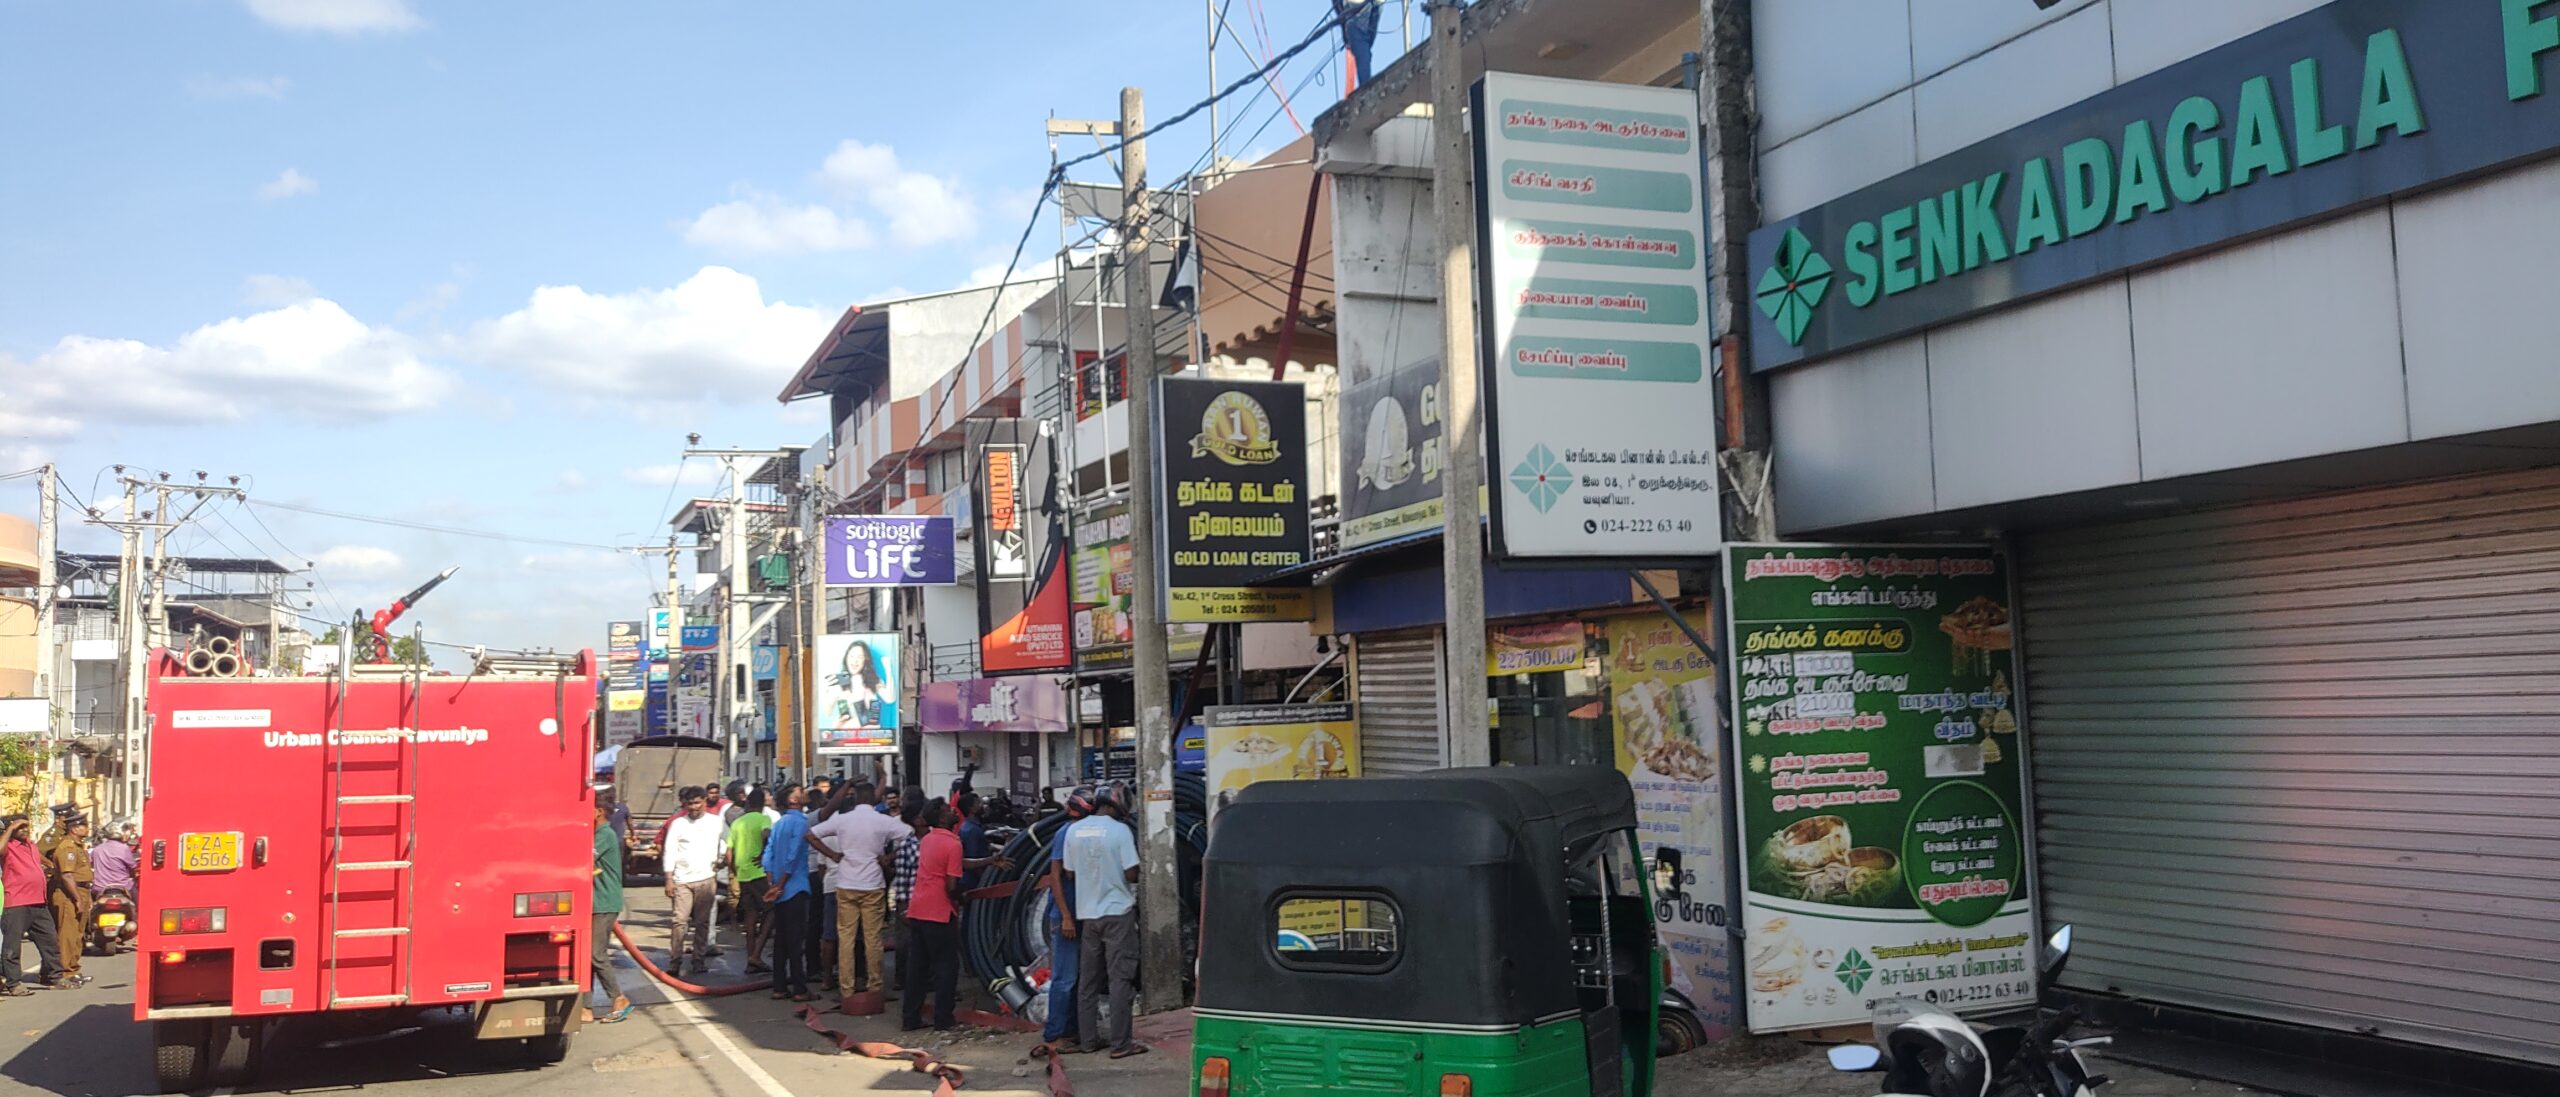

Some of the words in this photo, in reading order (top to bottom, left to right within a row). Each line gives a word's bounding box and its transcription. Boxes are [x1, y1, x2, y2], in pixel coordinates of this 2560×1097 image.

[1507, 111, 1546, 127] தங்க
[1551, 118, 1588, 131] நகை
[1844, 27, 2424, 308] SENKADAGALA
[1600, 293, 1646, 311] வைப்பு
[1519, 349, 1574, 367] சேமிப்பு
[1578, 352, 1626, 369] வைப்பு
[1227, 409, 1248, 441] 1
[1239, 449, 1274, 460] LOAN
[988, 451, 1012, 530] KEVILTON
[1177, 476, 1233, 507] தங்க
[1239, 478, 1295, 504] கடன்
[846, 521, 926, 545] softlogic
[1188, 511, 1285, 541] நிலையம்
[1601, 519, 1653, 532] 024-222
[1658, 519, 1673, 532] 63
[1677, 519, 1692, 532] 40
[1174, 551, 1210, 567] GOLD
[1213, 551, 1248, 567] LOAN
[1251, 551, 1301, 567] CENTER
[1212, 592, 1234, 600] Cross
[685, 628, 709, 638] TVS
[1744, 624, 1818, 655] தங்கக்
[1823, 622, 1905, 649] கணக்கு
[1497, 646, 1577, 669] 227500.00
[264, 731, 322, 747] Urban
[328, 728, 399, 746] Council
[190, 852, 230, 867] 6506
[1940, 984, 1993, 1004] 024-222
[1995, 982, 2011, 998] 63
[2014, 980, 2030, 995] 40
